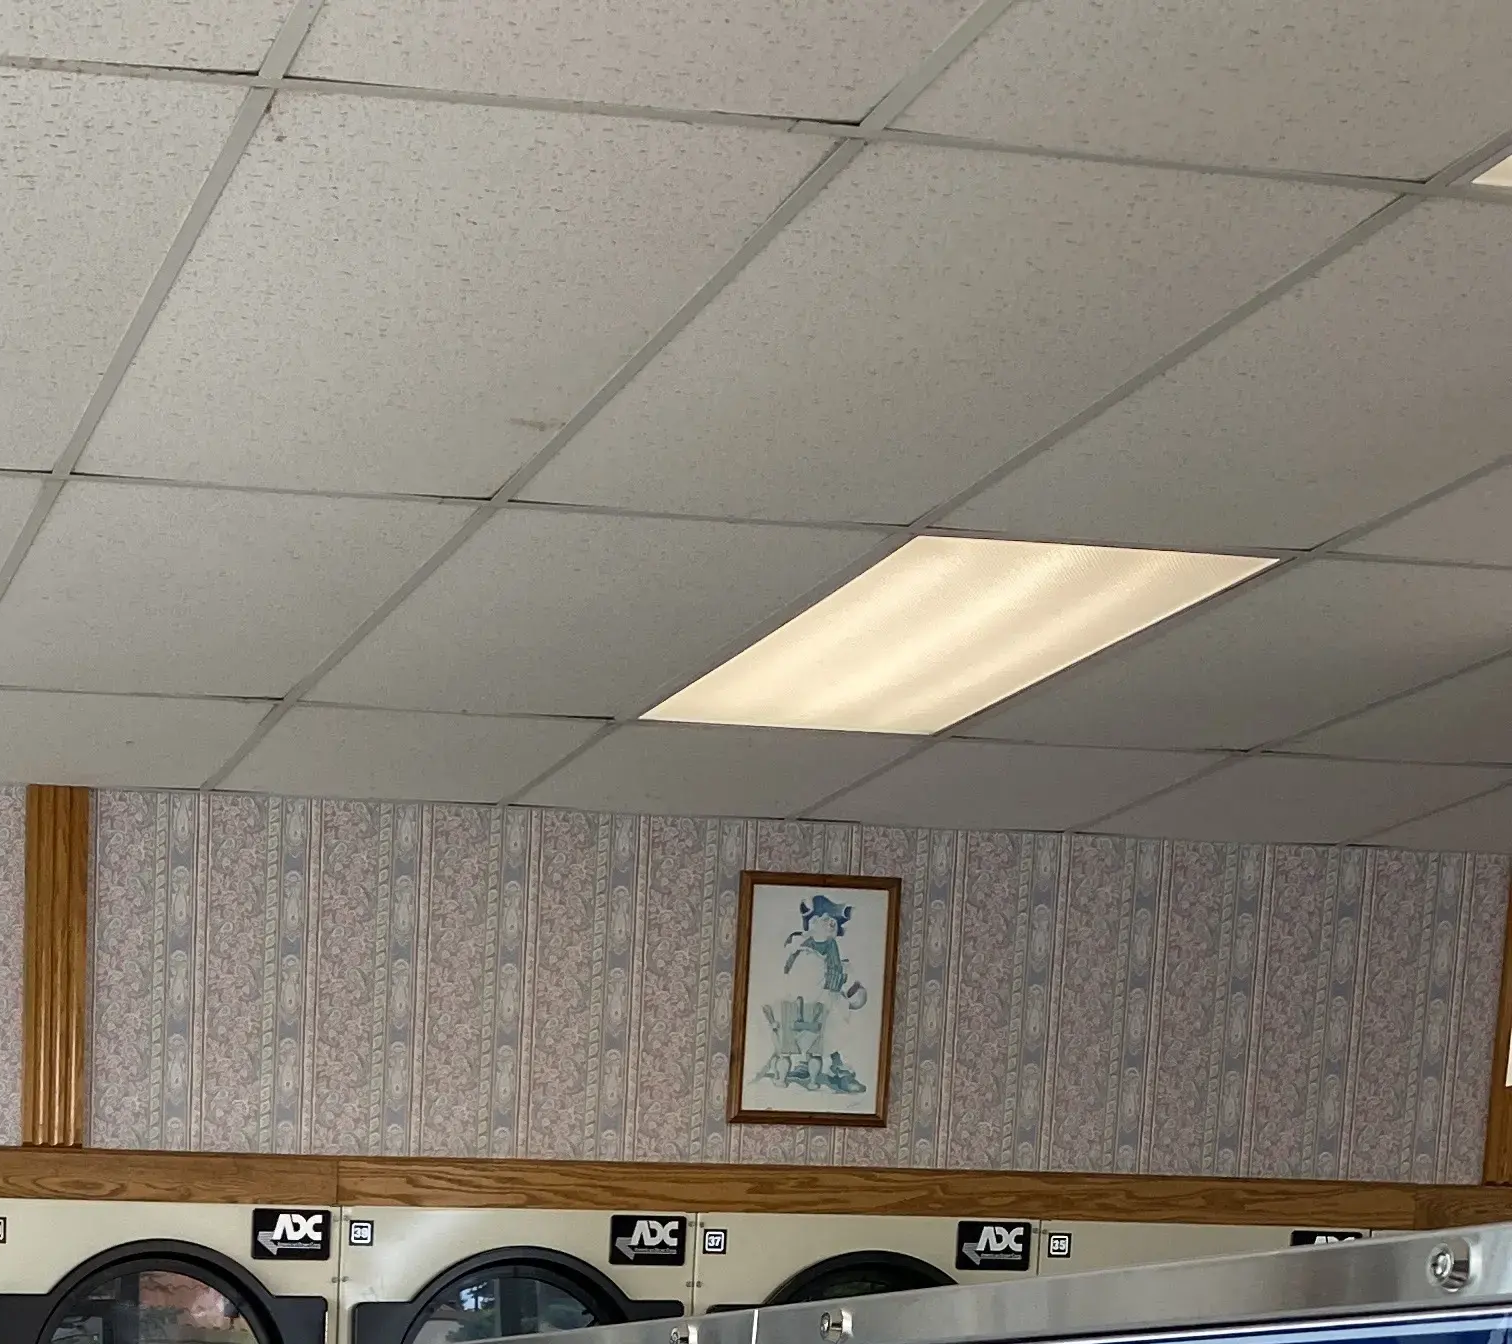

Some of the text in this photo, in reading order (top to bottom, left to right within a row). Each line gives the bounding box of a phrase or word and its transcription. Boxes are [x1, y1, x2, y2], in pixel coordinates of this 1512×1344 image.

[272, 1213, 323, 1240] ADC
[629, 1220, 679, 1246] ADC
[975, 1226, 1024, 1252] ADC
[708, 1236, 721, 1247] 37
[1051, 1239, 1067, 1251] 35
